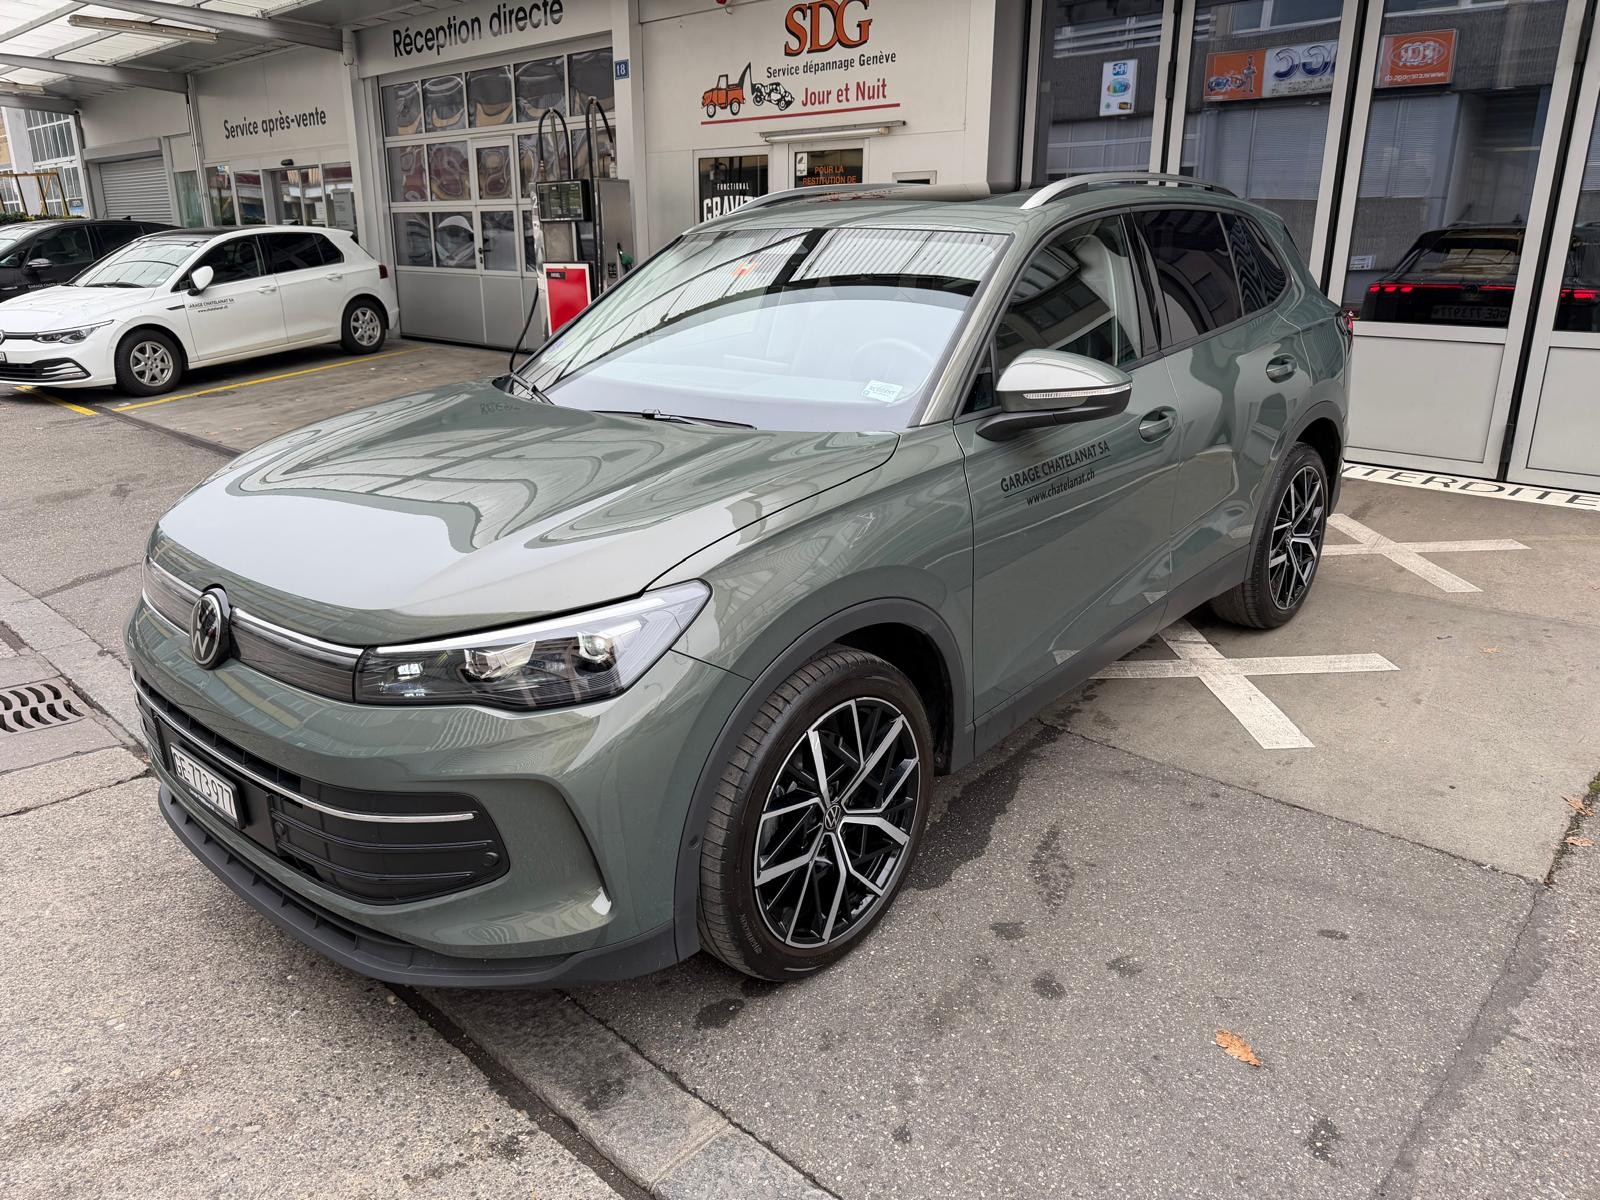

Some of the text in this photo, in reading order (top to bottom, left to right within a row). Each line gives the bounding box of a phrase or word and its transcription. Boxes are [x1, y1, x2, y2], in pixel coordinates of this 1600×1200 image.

[392, 0, 563, 57] Réception directe
[784, 0, 873, 57] SDG
[616, 63, 626, 76] 18
[766, 51, 897, 79] Service dépannage Genève
[801, 78, 887, 107] Jour et Nuit
[223, 106, 327, 139] Service après-vente
[802, 175, 857, 185] RESTITUTION DE
[814, 165, 834, 174] POUR
[835, 164, 844, 173] LA
[188, 301, 203, 310] ARAGE
[1000, 440, 1111, 493] GARAGE CHATELANAT SA
[1026, 467, 1095, 506] www.chatelanat.ch
